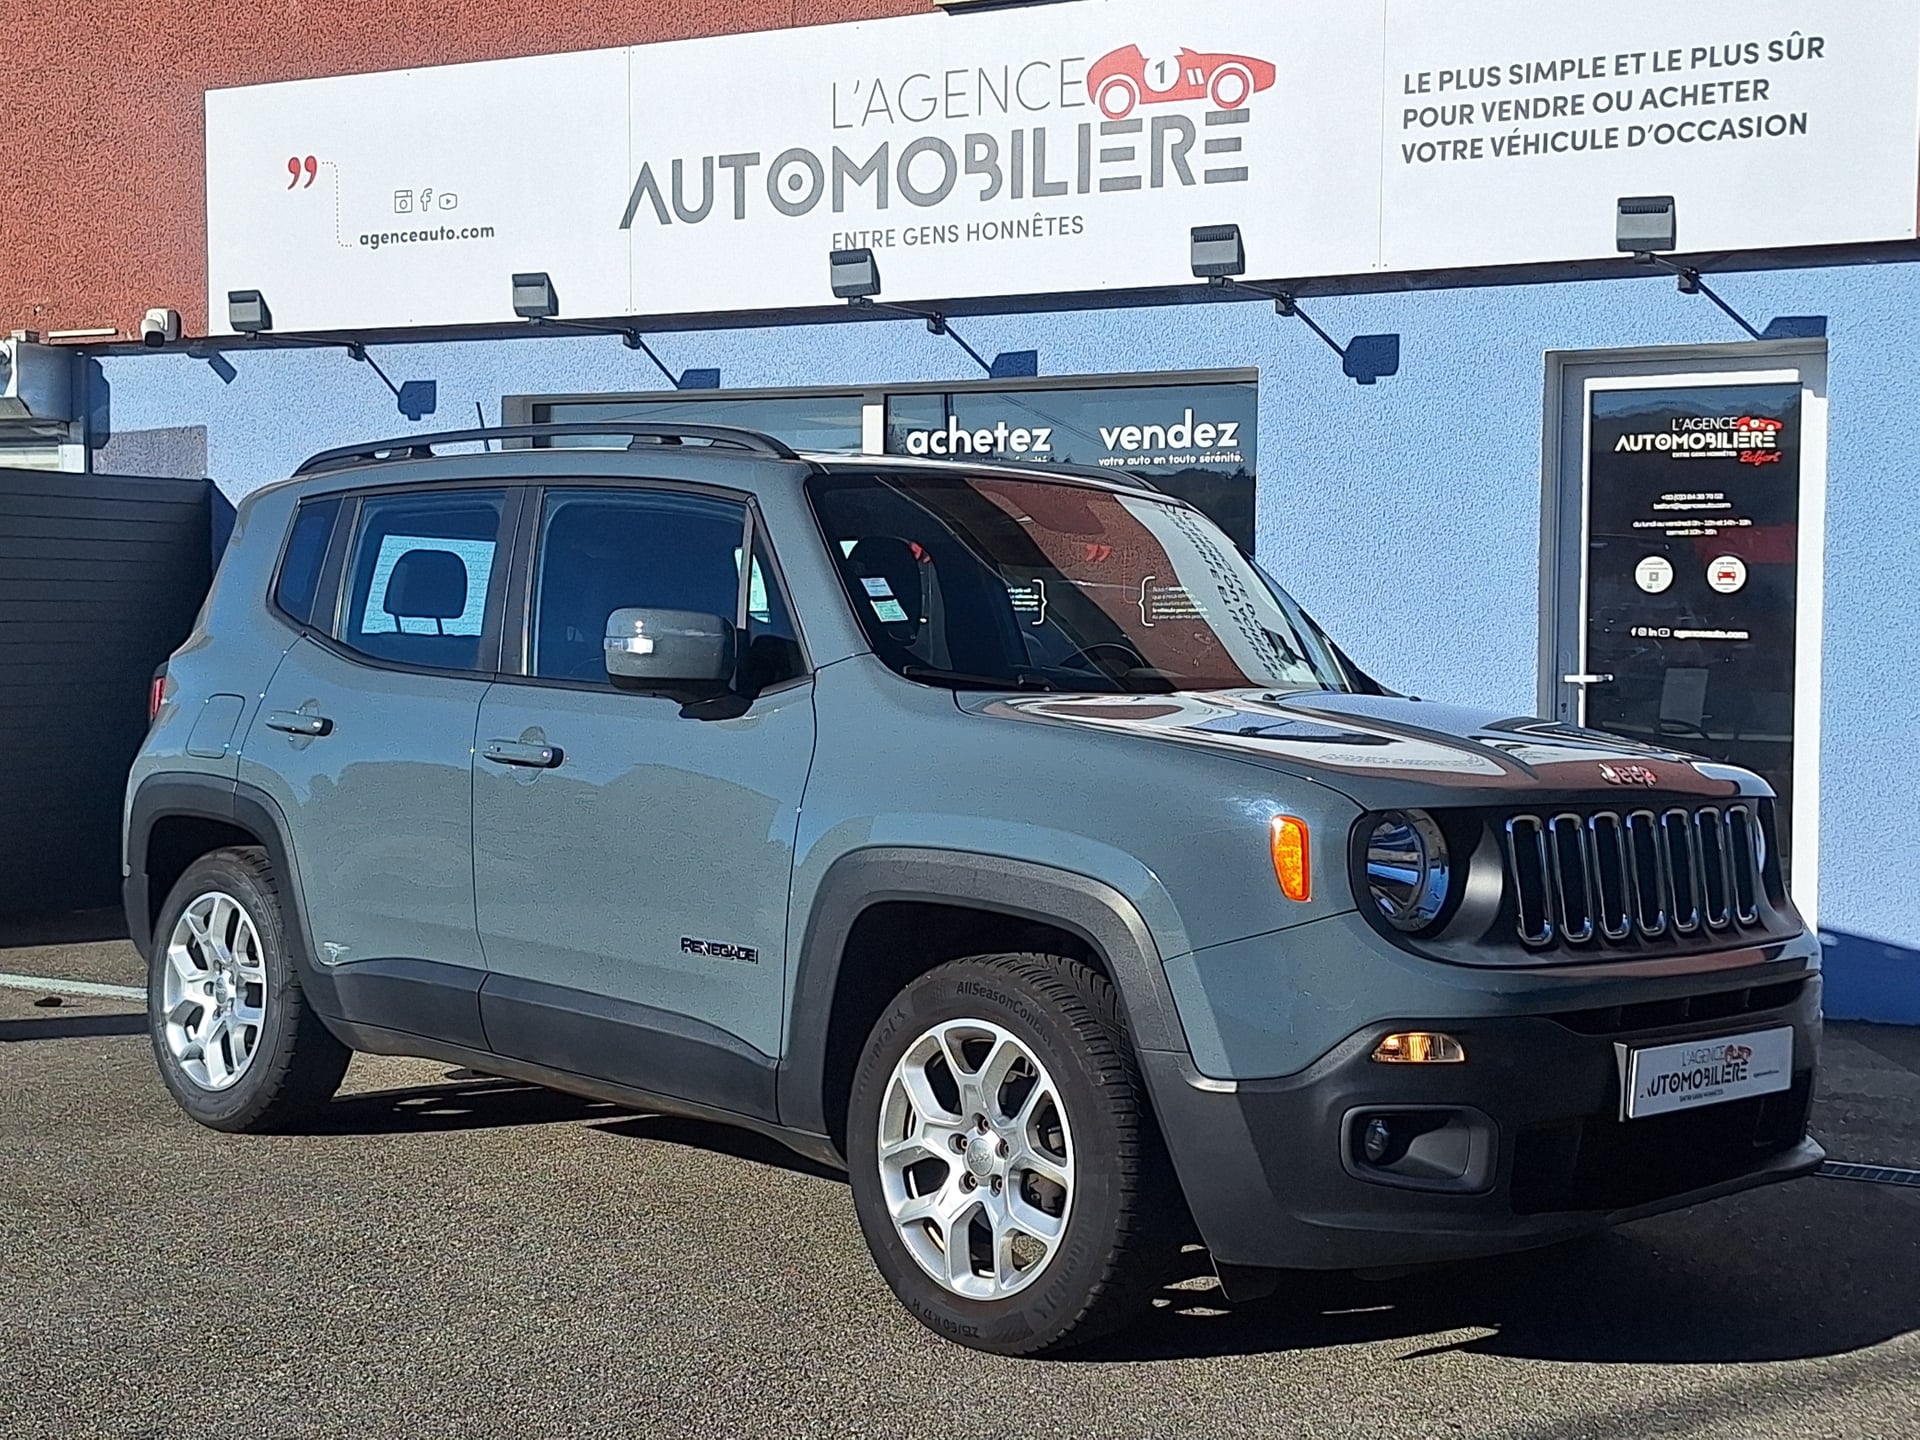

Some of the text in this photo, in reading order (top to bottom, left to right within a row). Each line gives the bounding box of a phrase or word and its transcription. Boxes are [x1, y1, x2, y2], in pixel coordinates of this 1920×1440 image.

[1404, 31, 1825, 95] LE PLUS SIMPLE ET LE PLUS SÛR
[833, 57, 1086, 129] L'AGENCE
[1403, 79, 1769, 130] POUR VENDRE OU ACHETER
[1401, 113, 1807, 164] VOTRE VÉHICULE D'OCCASION
[359, 224, 495, 250] agenceauto.com
[832, 212, 1084, 252] ENTRE GENS HONNÊTES
[906, 415, 1052, 454] achetez
[1099, 408, 1239, 451] vendez
[1672, 417, 1738, 431] L'AGENCE
[1098, 456, 1124, 466] votre
[1127, 455, 1151, 465] auto
[1153, 456, 1166, 464] en
[1169, 454, 1196, 463] toute
[1598, 763, 1657, 788] Jeep
[681, 936, 759, 964] RENEGADE
